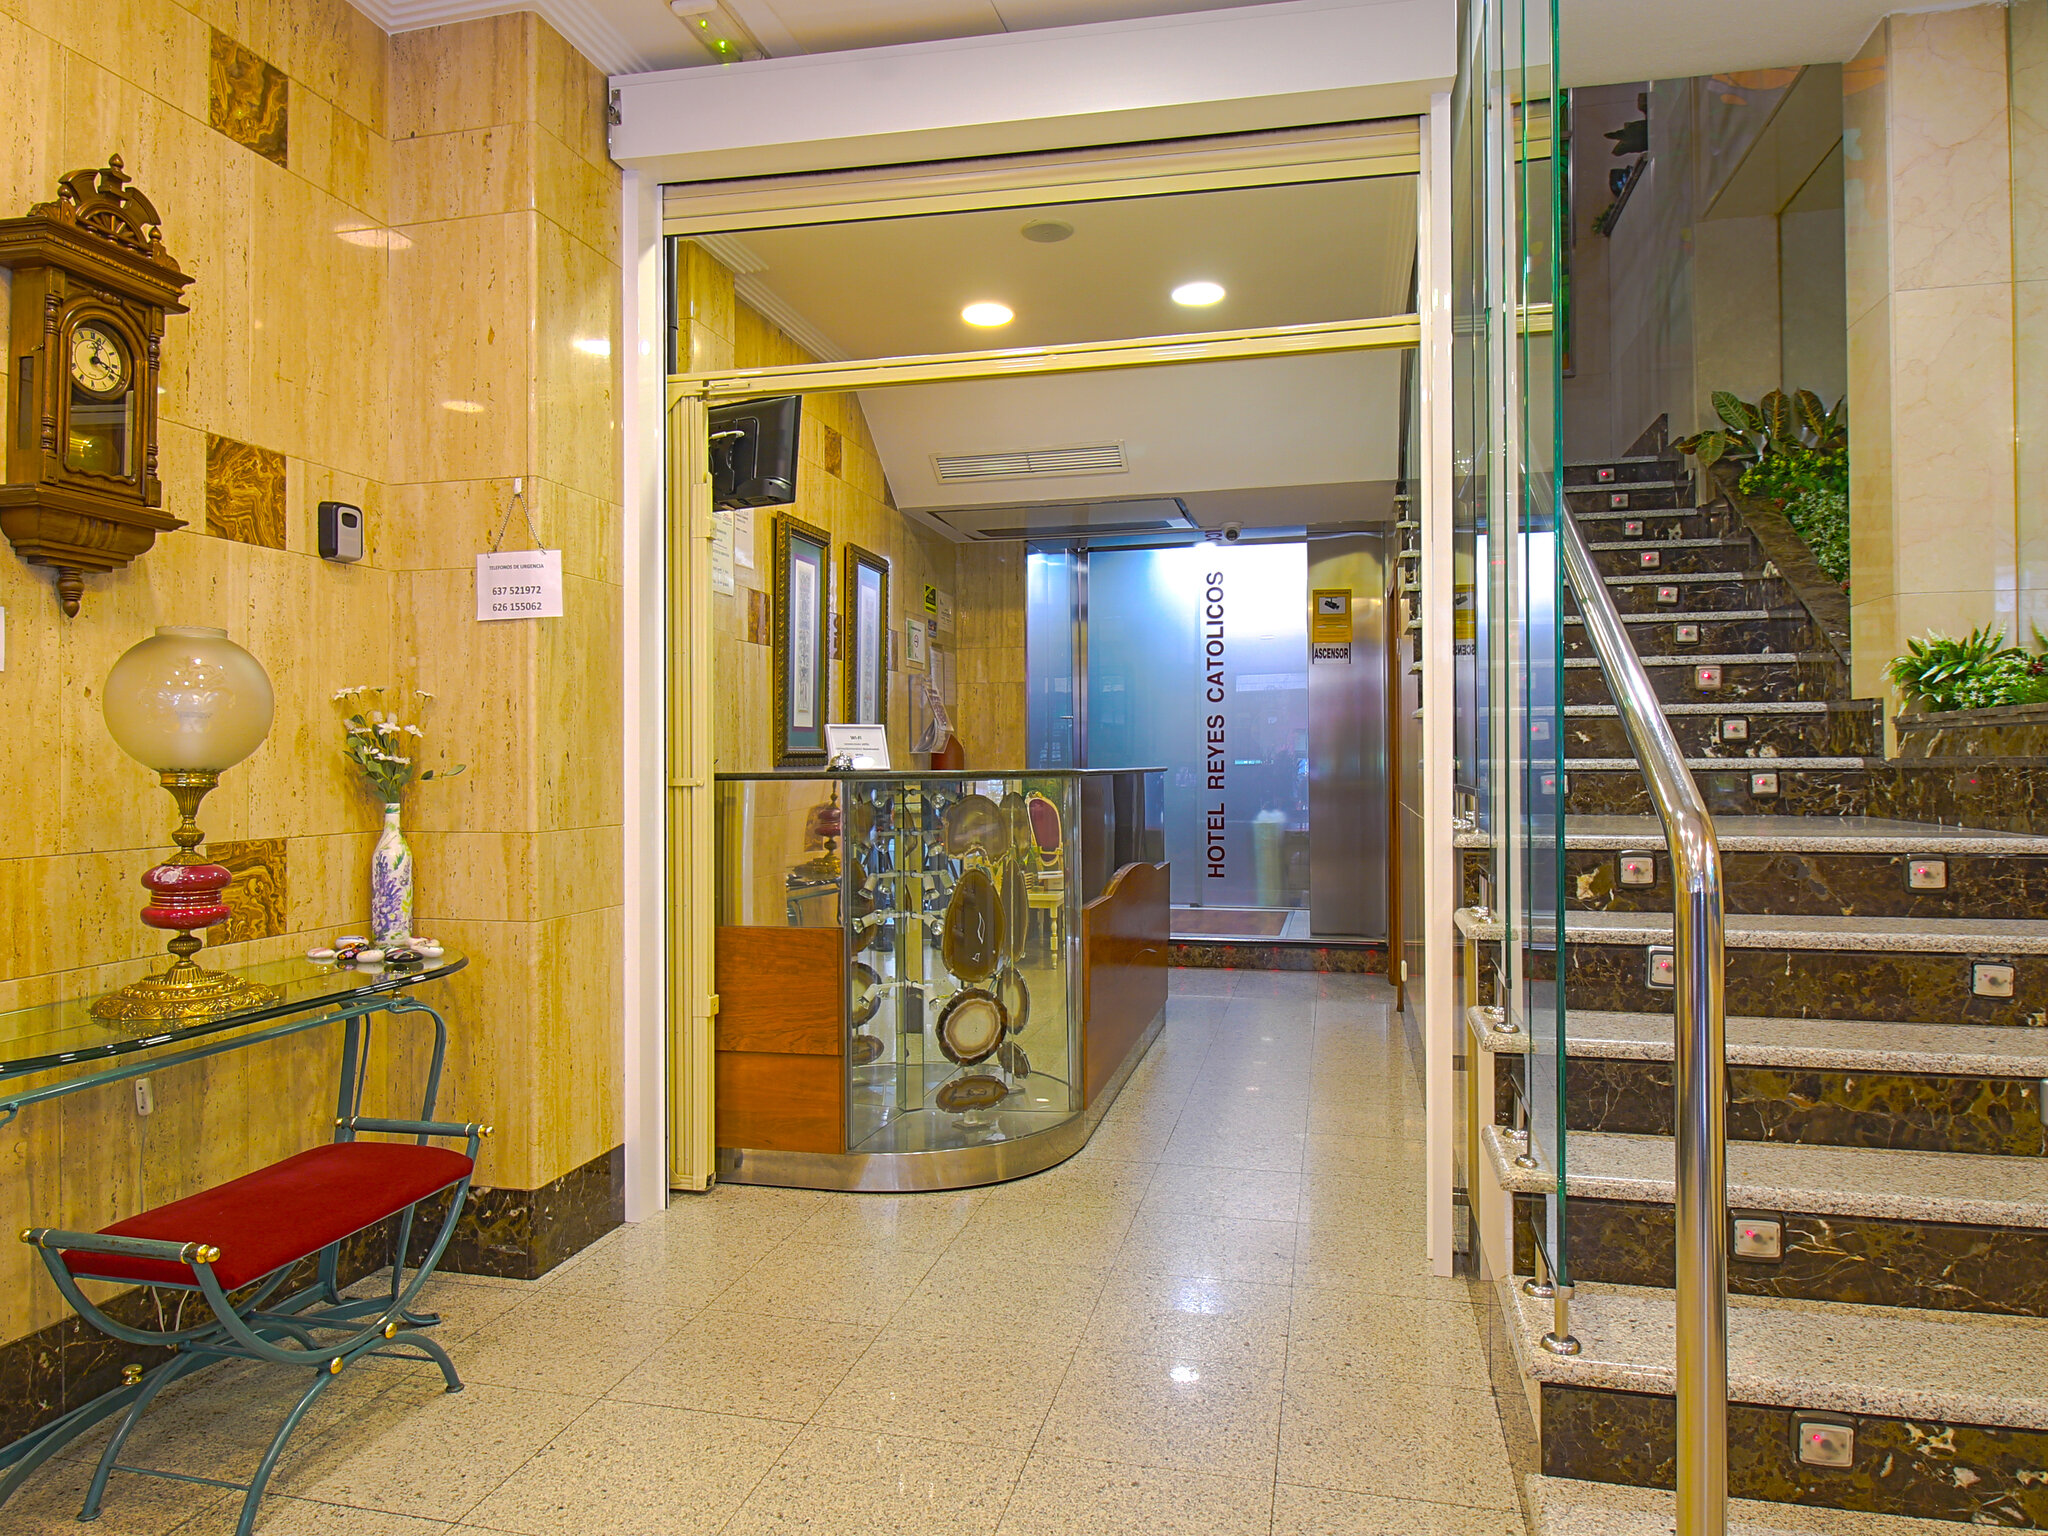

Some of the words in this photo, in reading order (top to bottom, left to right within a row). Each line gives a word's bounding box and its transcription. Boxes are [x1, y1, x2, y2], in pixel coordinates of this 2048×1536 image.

[492, 587, 507, 595] 637
[509, 585, 542, 595] 521972
[492, 603, 508, 612] 626
[510, 602, 542, 611] 155062
[1206, 571, 1225, 703] CATOLICOS
[1314, 647, 1349, 660] ASCENSOR
[1206, 714, 1226, 790] REYES
[1207, 802, 1226, 878] HOTEL
